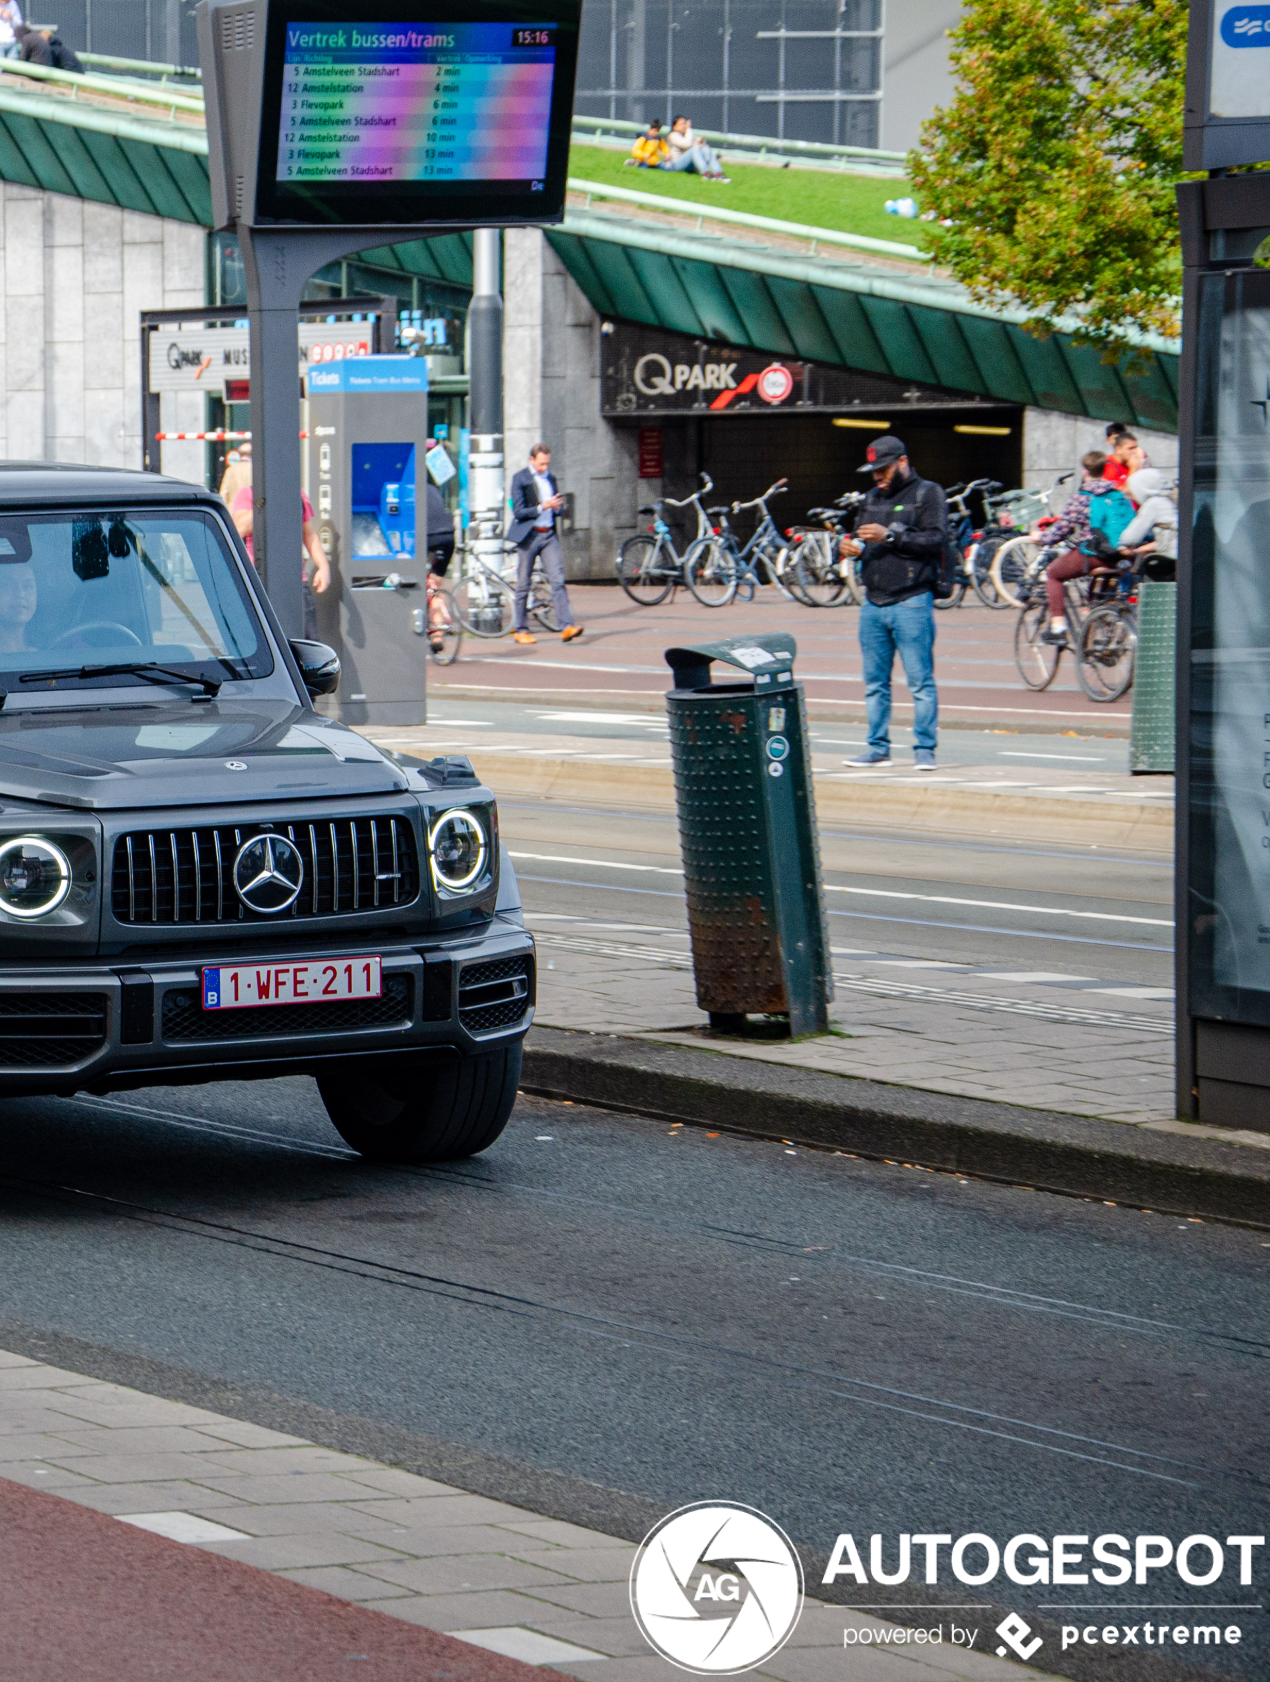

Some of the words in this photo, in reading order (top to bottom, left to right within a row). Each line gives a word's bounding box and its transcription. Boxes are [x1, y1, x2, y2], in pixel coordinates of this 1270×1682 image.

[288, 30, 347, 47] Vertrek
[351, 30, 455, 48] bussen/trams
[517, 30, 549, 44] 15:16
[294, 66, 300, 76] 5
[303, 66, 355, 76] Amstelveen
[357, 66, 400, 76] Stadshart
[435, 66, 442, 76] 2
[443, 66, 461, 76] min
[287, 83, 298, 93] 12
[301, 82, 364, 93] Amstelstation
[434, 83, 440, 93] 4
[442, 83, 460, 93] min
[292, 99, 297, 109] 3
[300, 99, 344, 111] Flevopark
[433, 99, 439, 109] 6
[441, 99, 458, 109] min
[290, 116, 296, 126] 5
[299, 116, 351, 126] Amstelveen
[354, 116, 397, 126] Stadshart
[432, 116, 438, 126] 6
[440, 116, 457, 126] min
[284, 133, 295, 142] 12
[298, 132, 360, 143] Amstelstation
[426, 132, 437, 142] 10
[439, 132, 455, 142] min
[288, 149, 294, 159] 3
[297, 149, 340, 160] Flevopark
[425, 149, 436, 159] 13
[437, 149, 454, 159] min
[287, 165, 293, 175] 5
[296, 165, 348, 176] Amstelveen
[350, 165, 392, 175] Stadshart
[423, 165, 435, 175] 13
[436, 165, 453, 175] min
[310, 370, 341, 386] Tickets
[207, 991, 219, 1004] B
